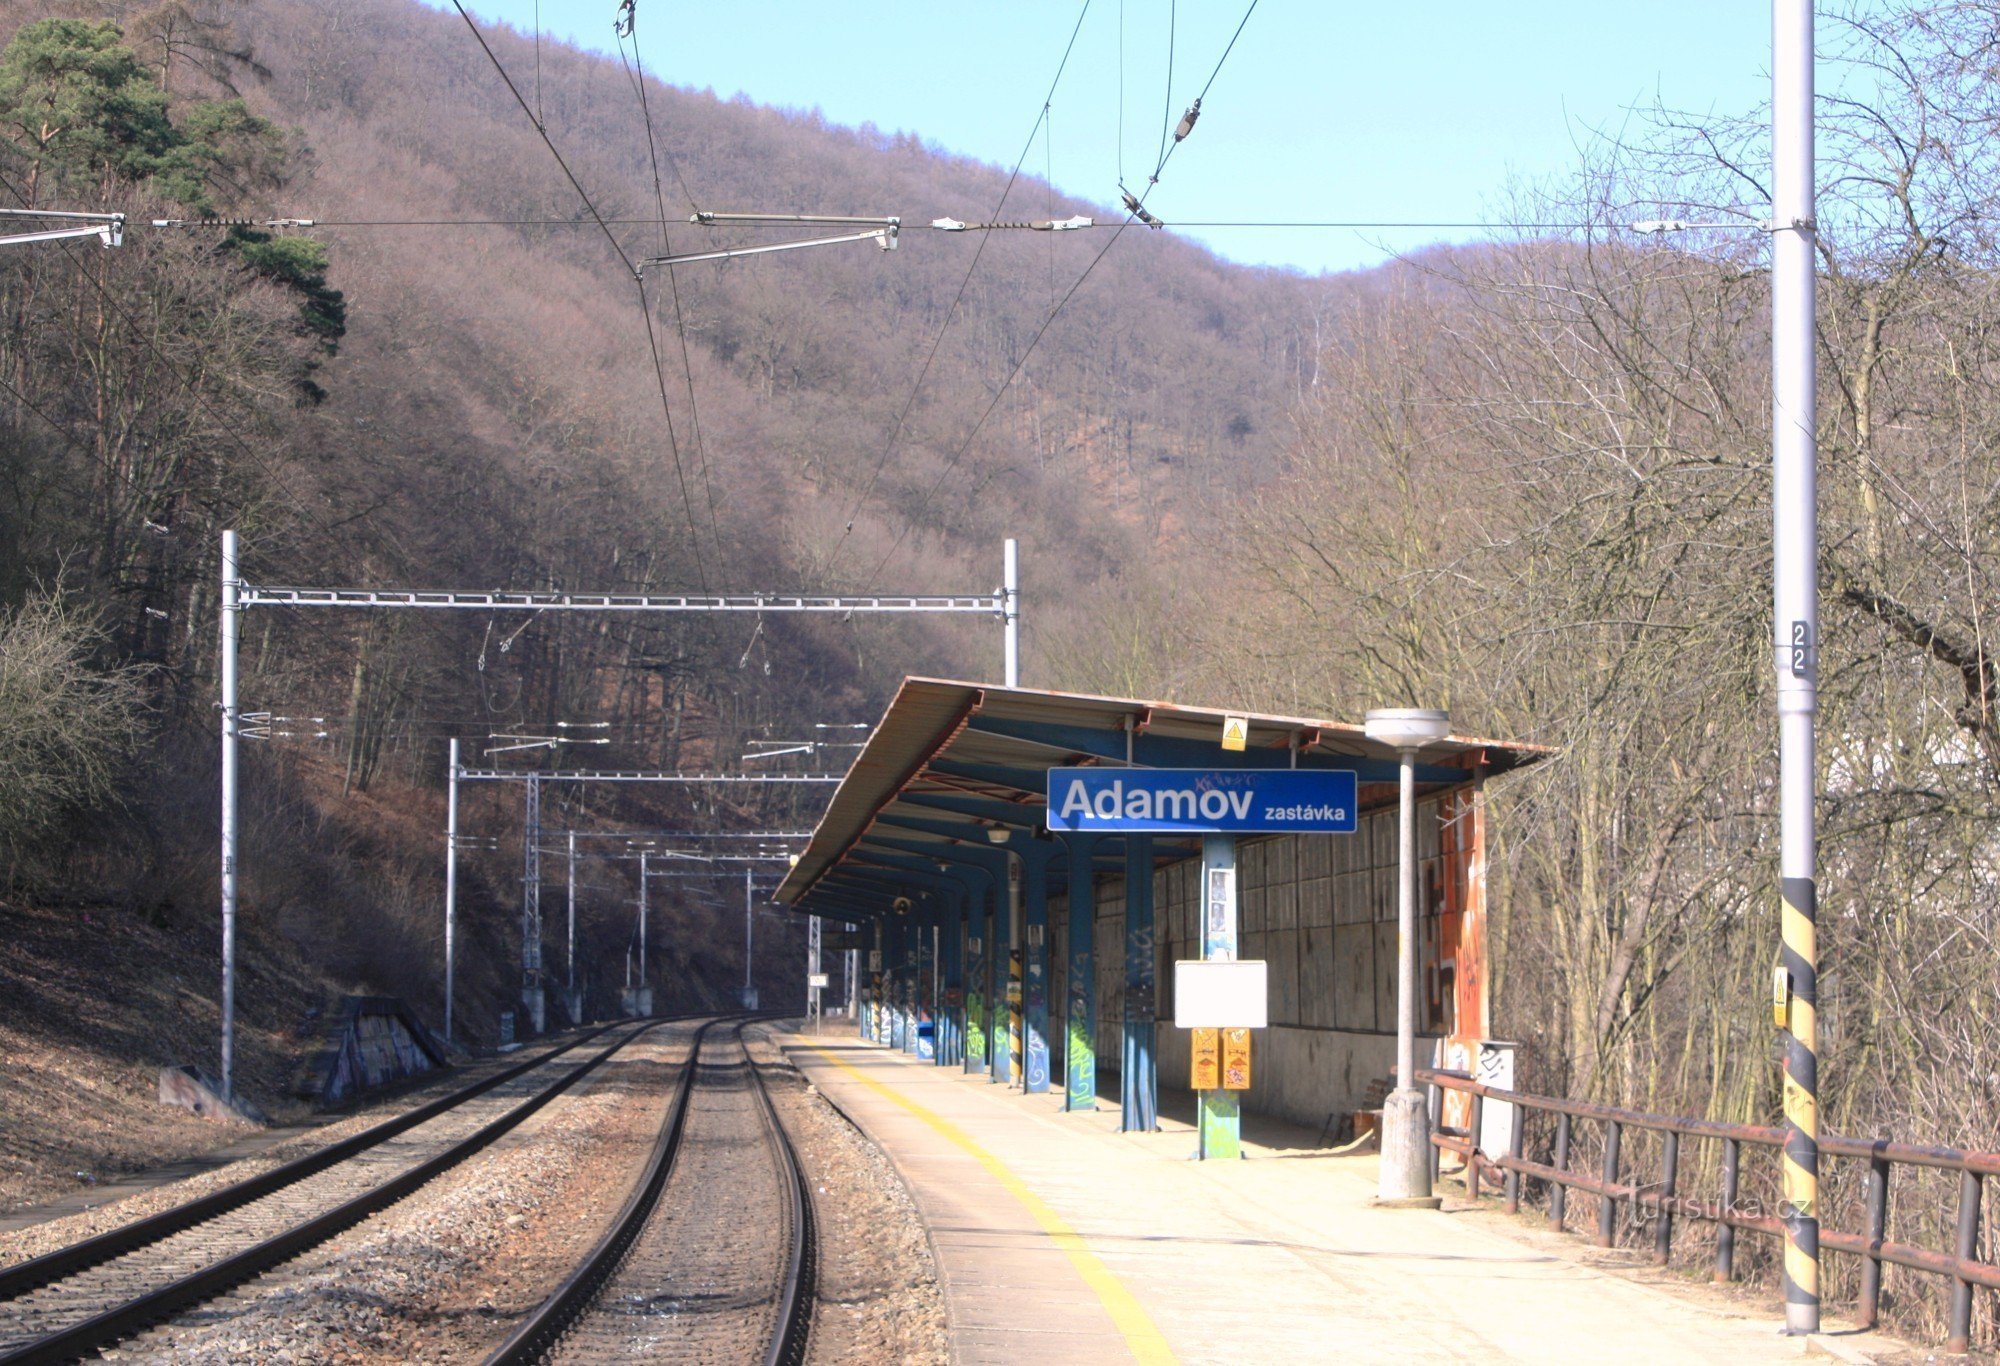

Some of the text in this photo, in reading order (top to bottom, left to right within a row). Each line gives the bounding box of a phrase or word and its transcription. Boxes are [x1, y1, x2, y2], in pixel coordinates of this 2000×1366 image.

[1794, 624, 1805, 670] 22
[1060, 779, 1254, 820] Adamov
[1264, 804, 1345, 821] zastávka
